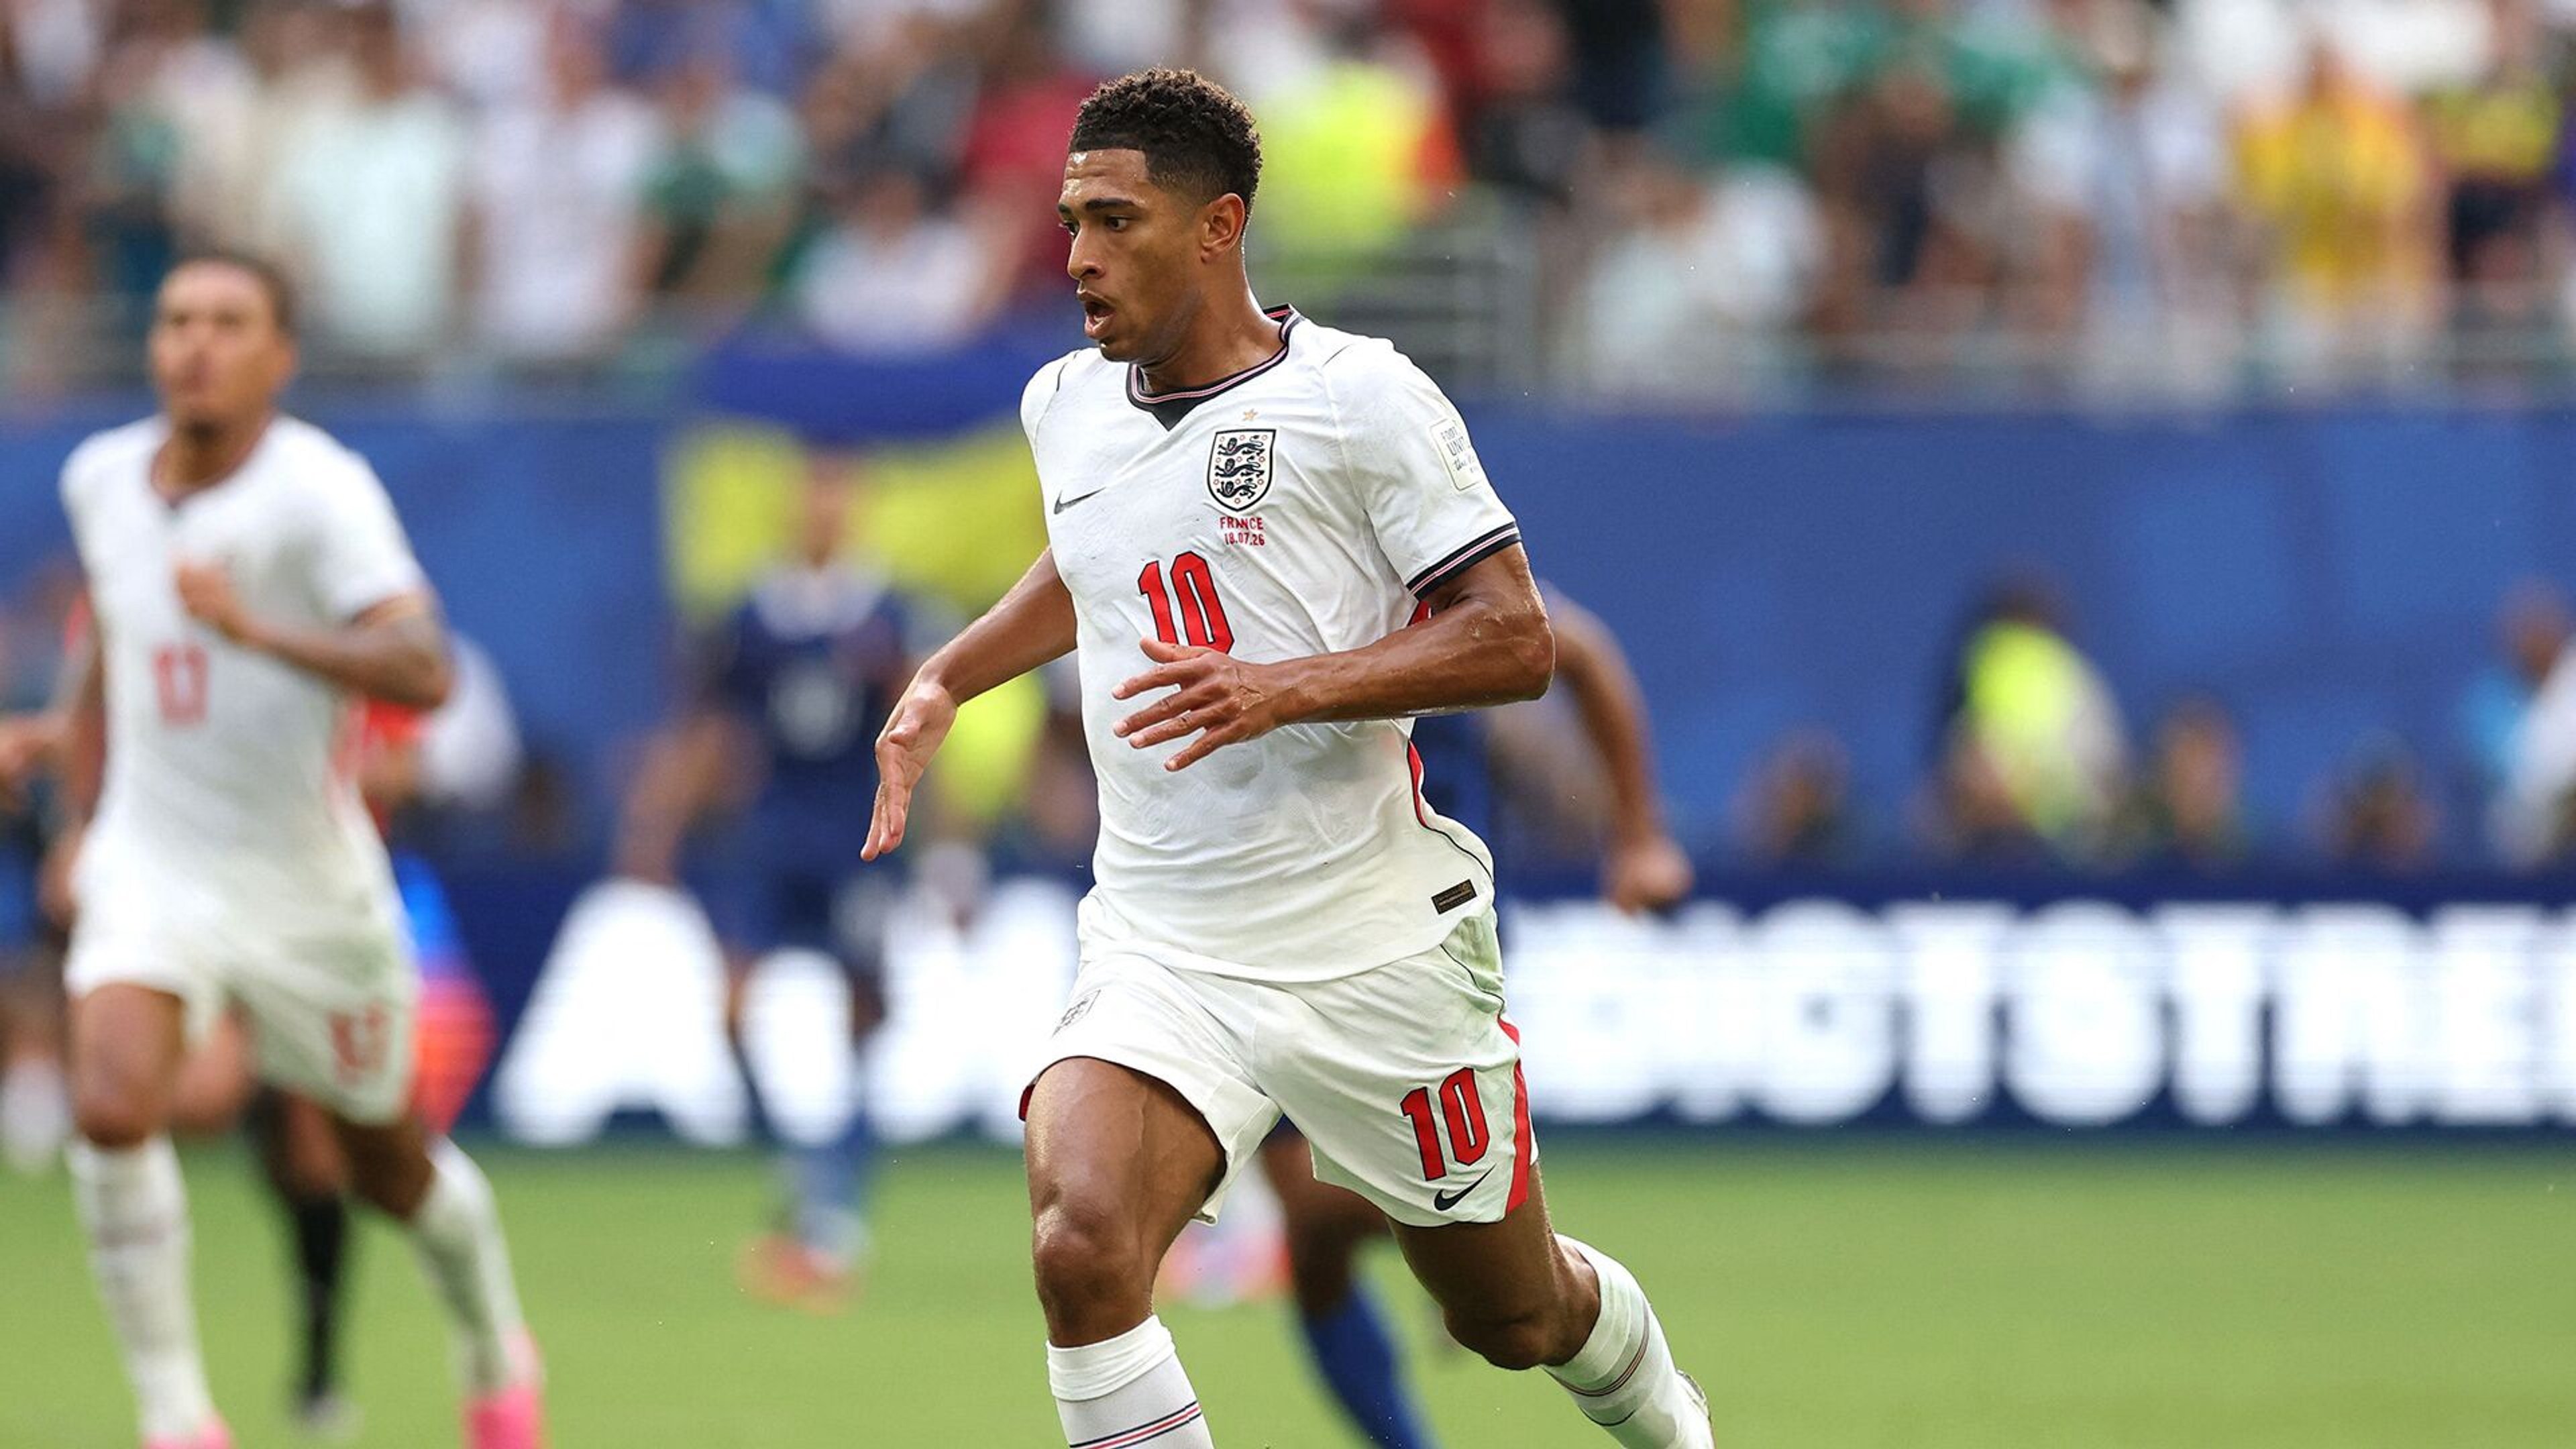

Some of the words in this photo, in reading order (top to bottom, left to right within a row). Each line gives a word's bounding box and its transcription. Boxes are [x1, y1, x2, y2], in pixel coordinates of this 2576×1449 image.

[1220, 515, 1264, 531] FRANCE
[1224, 532, 1265, 546] 18.07.26
[1138, 550, 1234, 655] 10
[1400, 1067, 1490, 1181] 10
